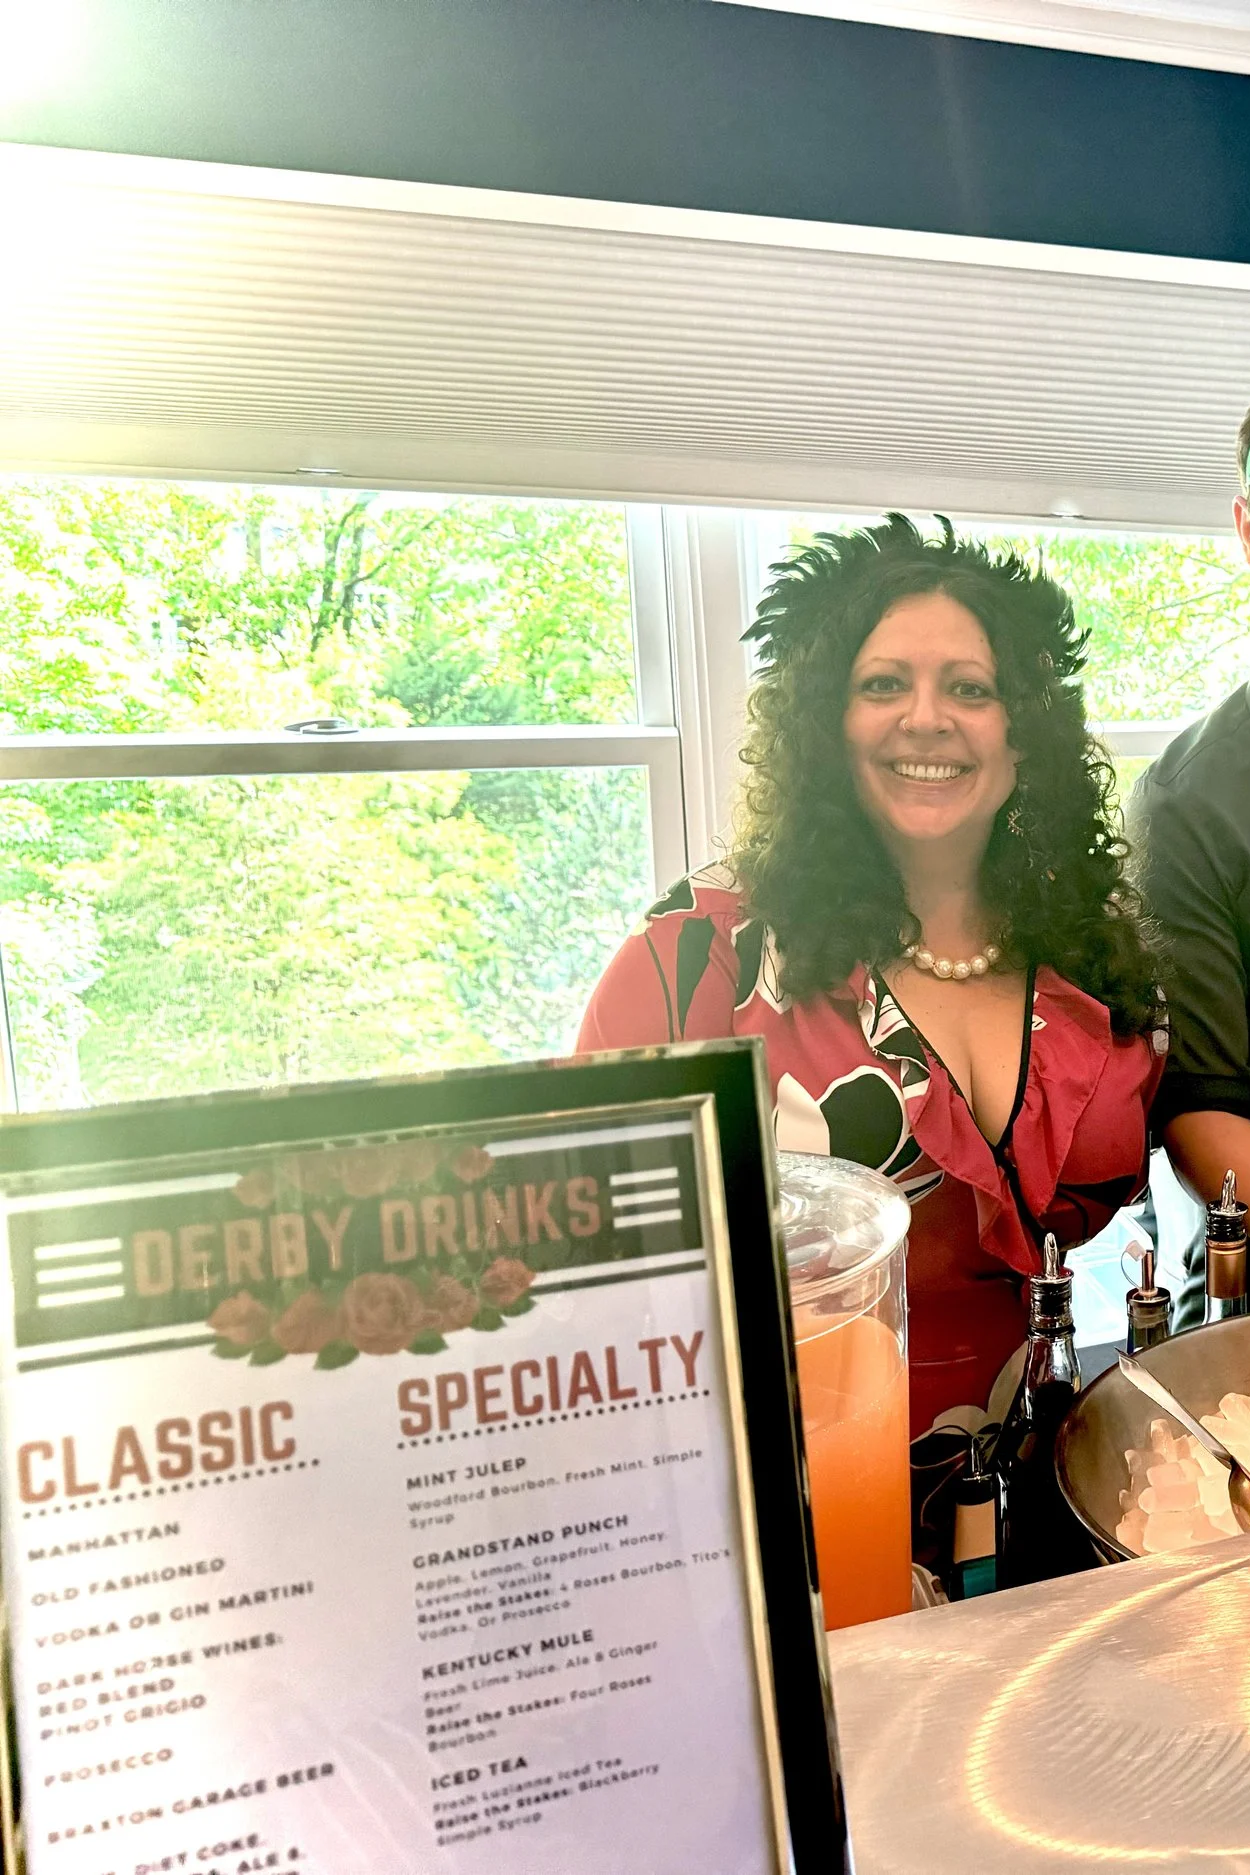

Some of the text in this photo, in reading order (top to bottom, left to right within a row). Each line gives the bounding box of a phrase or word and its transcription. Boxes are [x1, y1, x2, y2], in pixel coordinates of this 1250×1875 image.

[133, 1176, 603, 1300] DERBY DRINKS
[398, 1331, 706, 1438] SPECIALTY
[17, 1400, 297, 1505] CLASSIC
[407, 1457, 526, 1490] MINT JULEP
[407, 1489, 485, 1512] Woodford
[565, 1468, 605, 1483] Fresh
[653, 1450, 702, 1466] Simple
[28, 1522, 180, 1561] MANHATTAN
[410, 1514, 455, 1529] Syrup
[413, 1515, 628, 1568] GRANDSTAND PUNCH
[31, 1558, 225, 1606] OLD FASHIONED
[418, 1609, 460, 1624] Raise
[467, 1602, 493, 1614] the
[574, 1574, 615, 1589] Roses
[498, 1572, 551, 1590] Vanilla
[36, 1581, 313, 1648] VODKA OR GIN MARTINI
[478, 1617, 496, 1627] Or
[502, 1600, 571, 1621] Prosecco
[422, 1629, 593, 1680] KENTUCKY MULE
[424, 1684, 467, 1702] Fresh
[472, 1675, 510, 1690] Lime
[566, 1657, 590, 1668] Ale
[609, 1641, 657, 1658] Ginger
[37, 1671, 103, 1695] DARK
[39, 1678, 174, 1718] RED BLEND
[427, 1719, 470, 1735] Raise
[476, 1711, 502, 1723] the
[570, 1686, 604, 1701] Four
[609, 1675, 651, 1692] Roses
[40, 1695, 206, 1741] PINOT GRIGIO
[425, 1704, 460, 1718] Beer
[428, 1729, 496, 1752] Bourbon
[44, 1748, 173, 1787] PROSECCO
[173, 1780, 266, 1813] GARAGE
[276, 1763, 334, 1788] BEER
[431, 1757, 528, 1791] ICED TEA
[433, 1795, 476, 1813] Fresh
[558, 1766, 591, 1780] Iced
[596, 1758, 622, 1770] Tea
[435, 1813, 478, 1830] Raise
[484, 1804, 510, 1817] the
[579, 1764, 659, 1792] Blackberry
[437, 1812, 542, 1847] Simple Syrup
